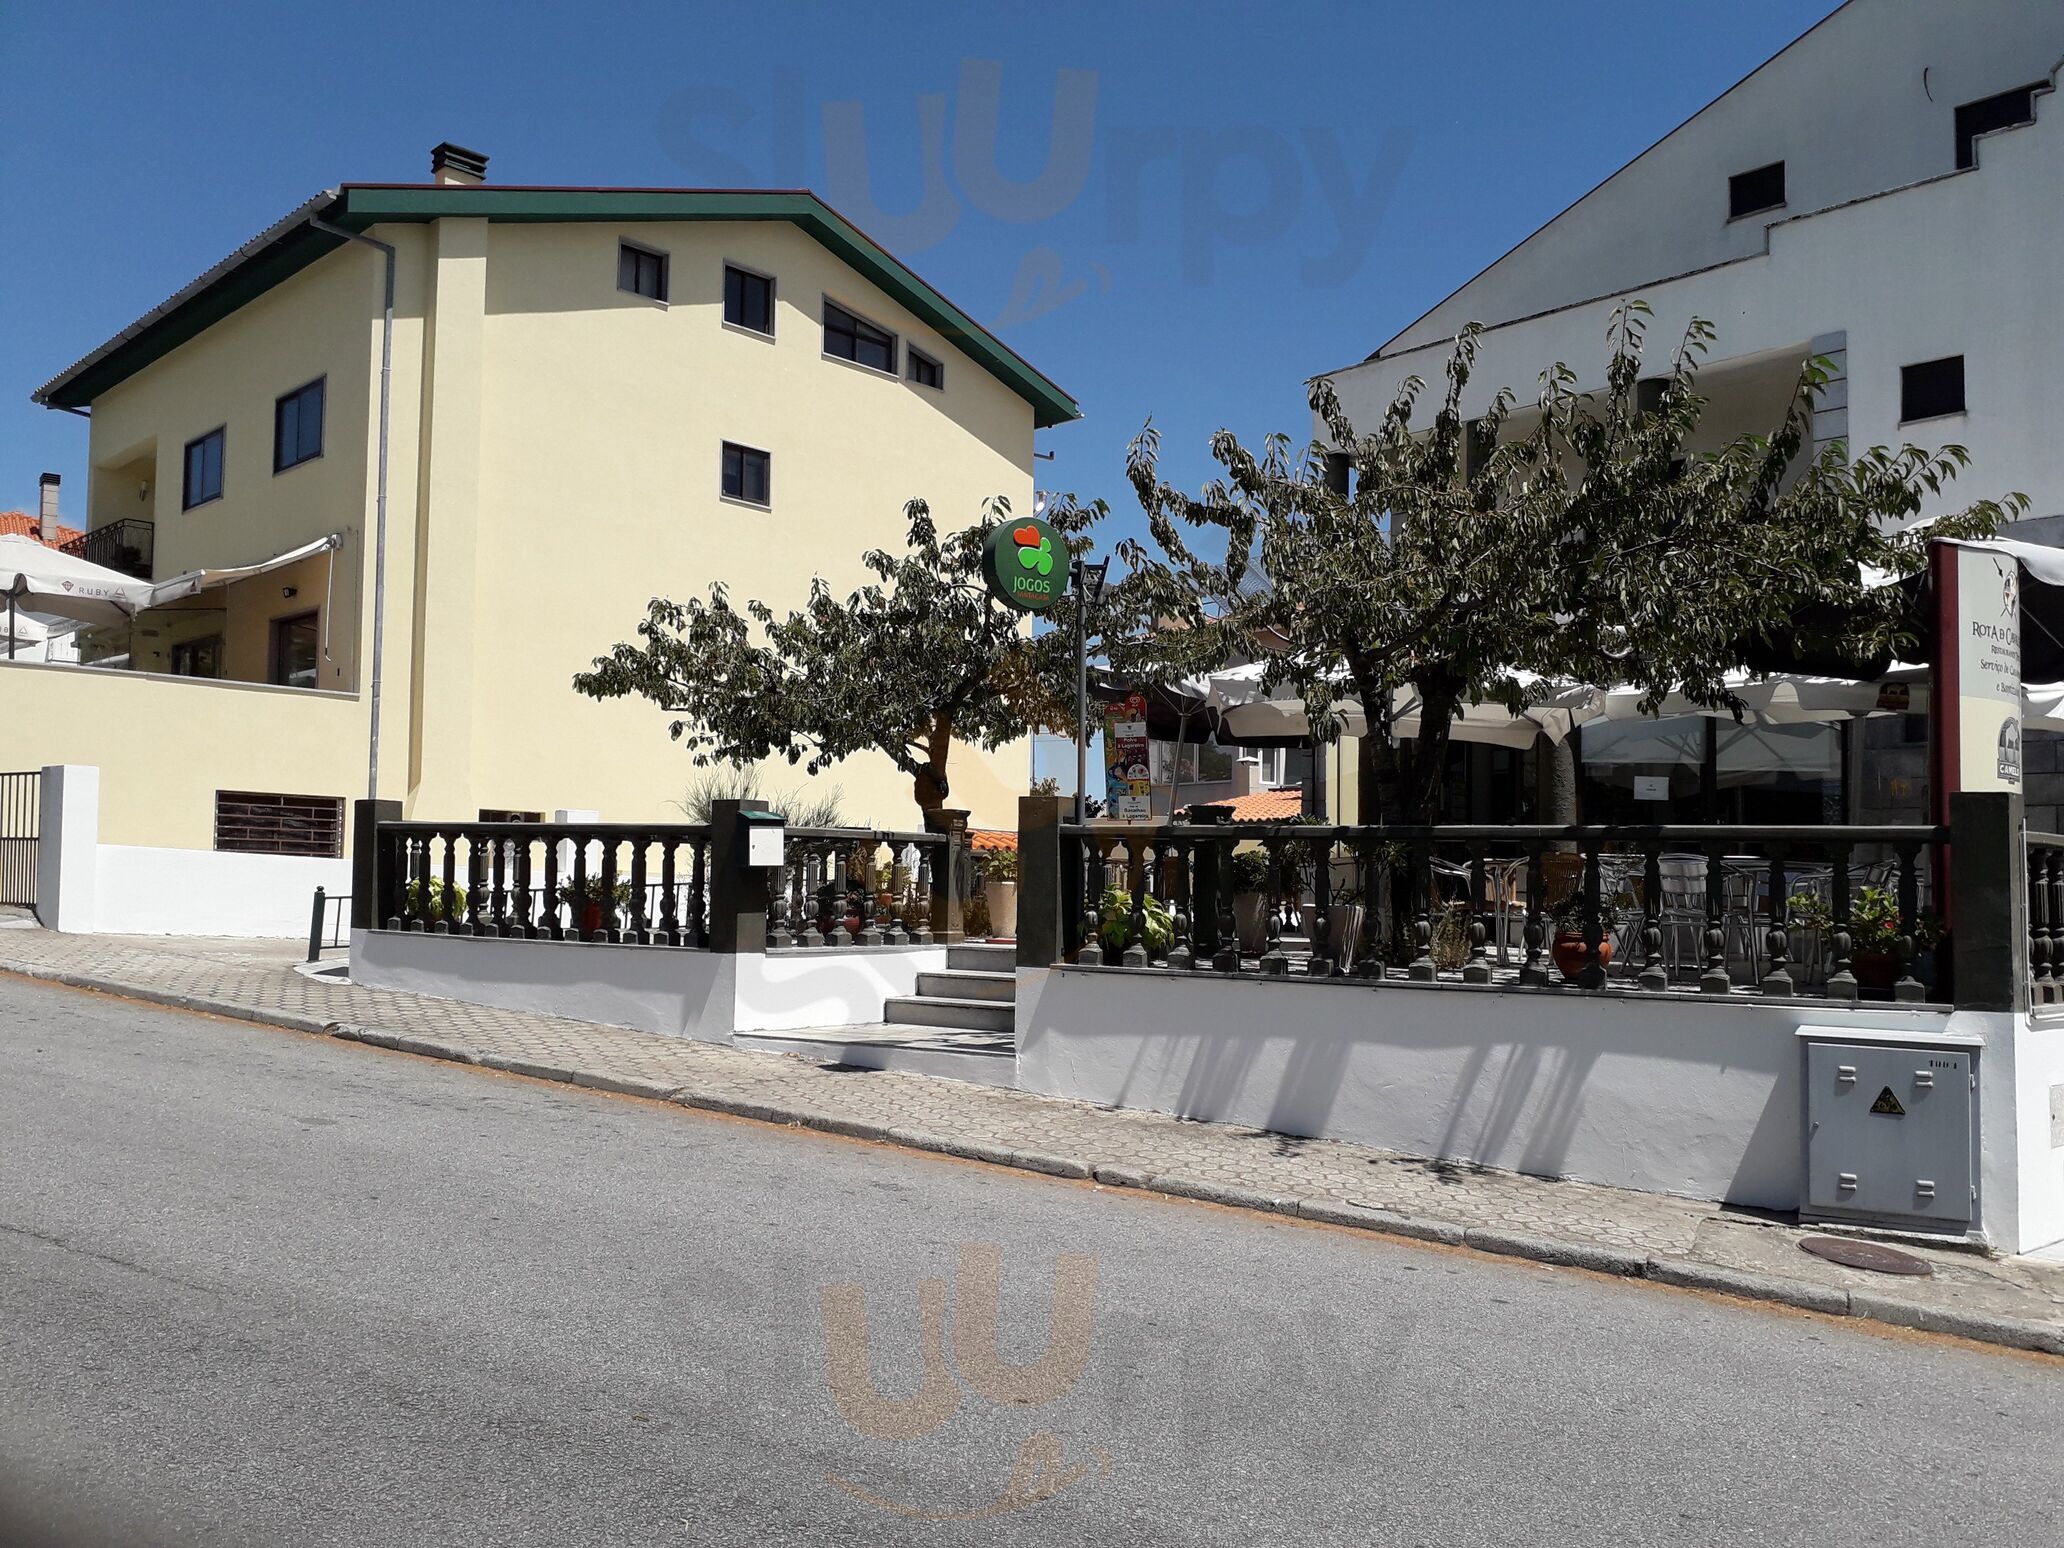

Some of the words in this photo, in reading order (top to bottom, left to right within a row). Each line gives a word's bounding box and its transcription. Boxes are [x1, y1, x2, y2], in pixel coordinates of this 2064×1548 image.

[78, 586, 109, 597] RUBY
[1012, 575, 1051, 593] JOGOS
[1972, 620, 1999, 642] ROTA
